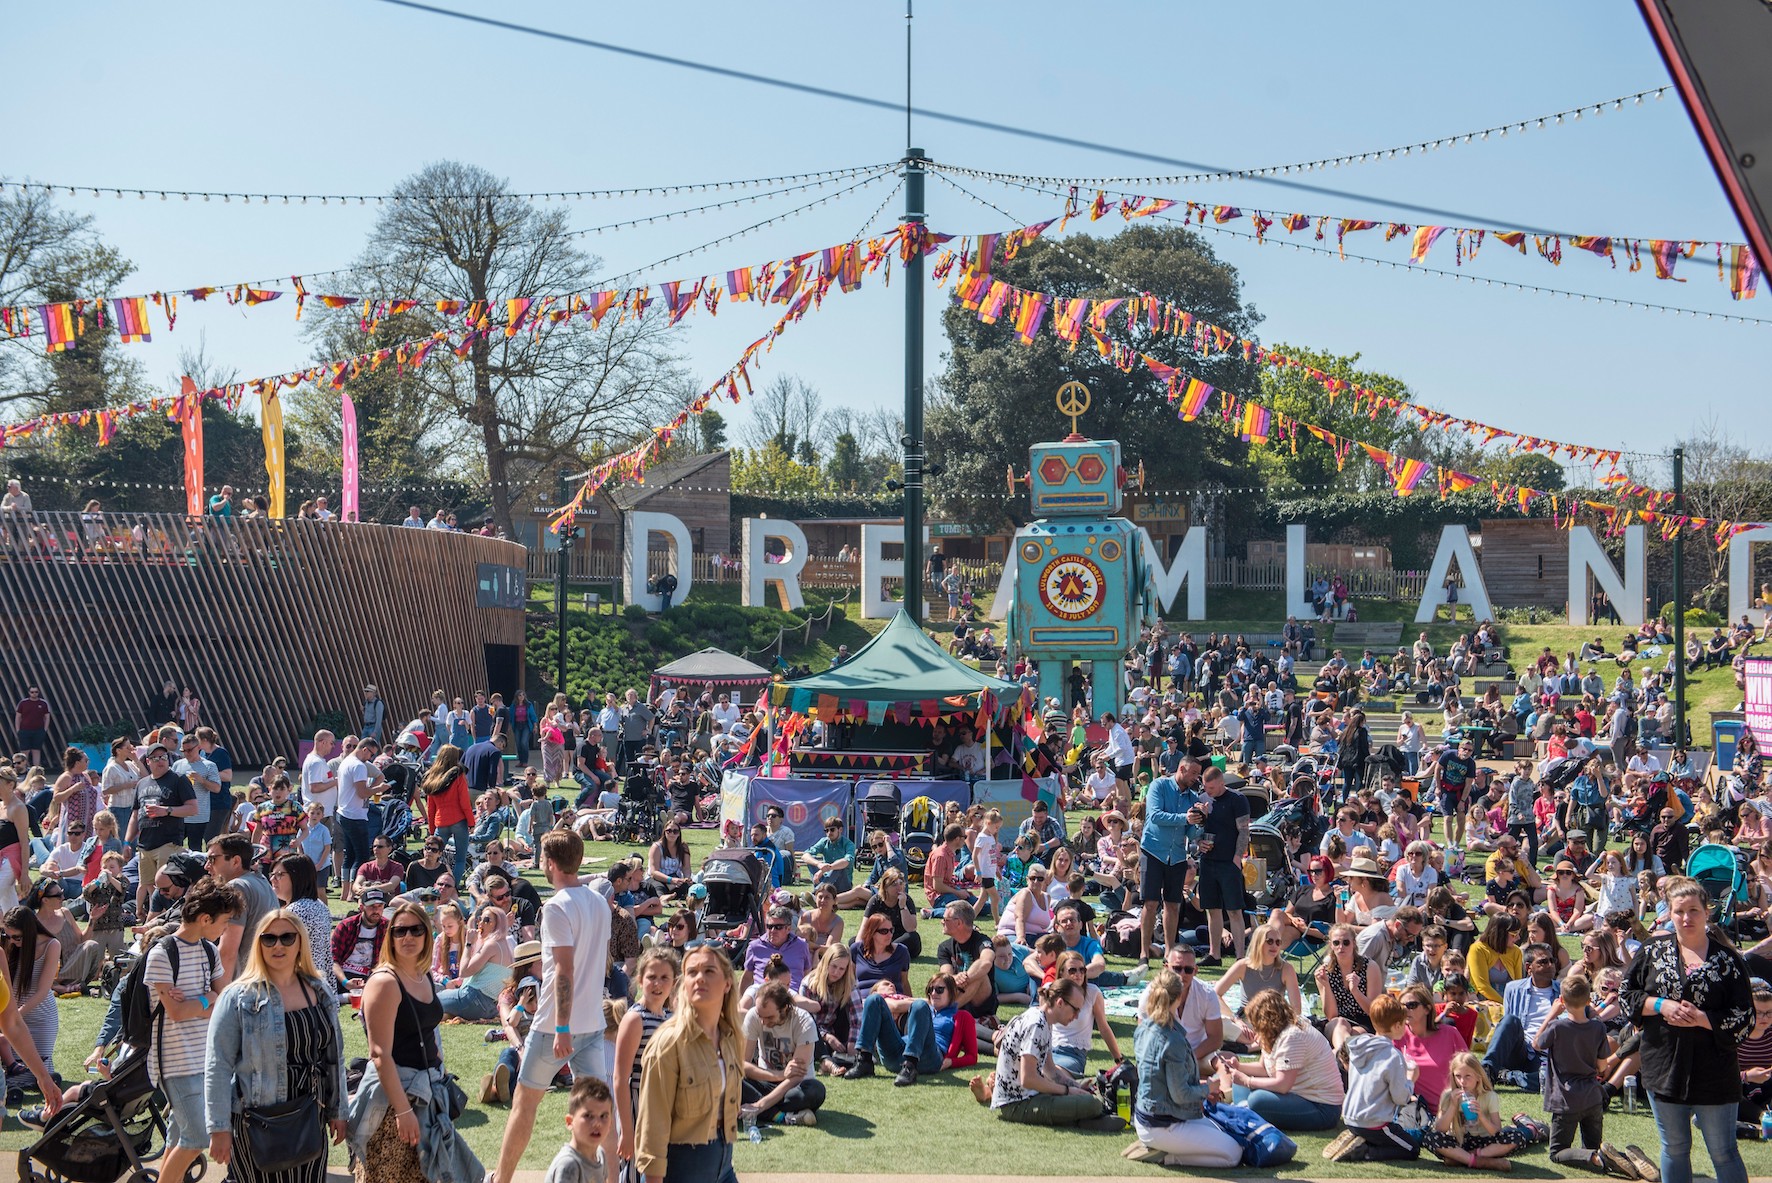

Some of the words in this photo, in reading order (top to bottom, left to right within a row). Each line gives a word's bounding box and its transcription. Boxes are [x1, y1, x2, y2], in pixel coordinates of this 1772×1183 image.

[1138, 504, 1180, 518] SPHINX
[624, 511, 1772, 627] DREMLAND
[1040, 559, 1060, 591] LULWORTH
[1087, 562, 1104, 585] DORSET
[1056, 566, 1086, 577] CAMP
[1069, 612, 1085, 620] JULY
